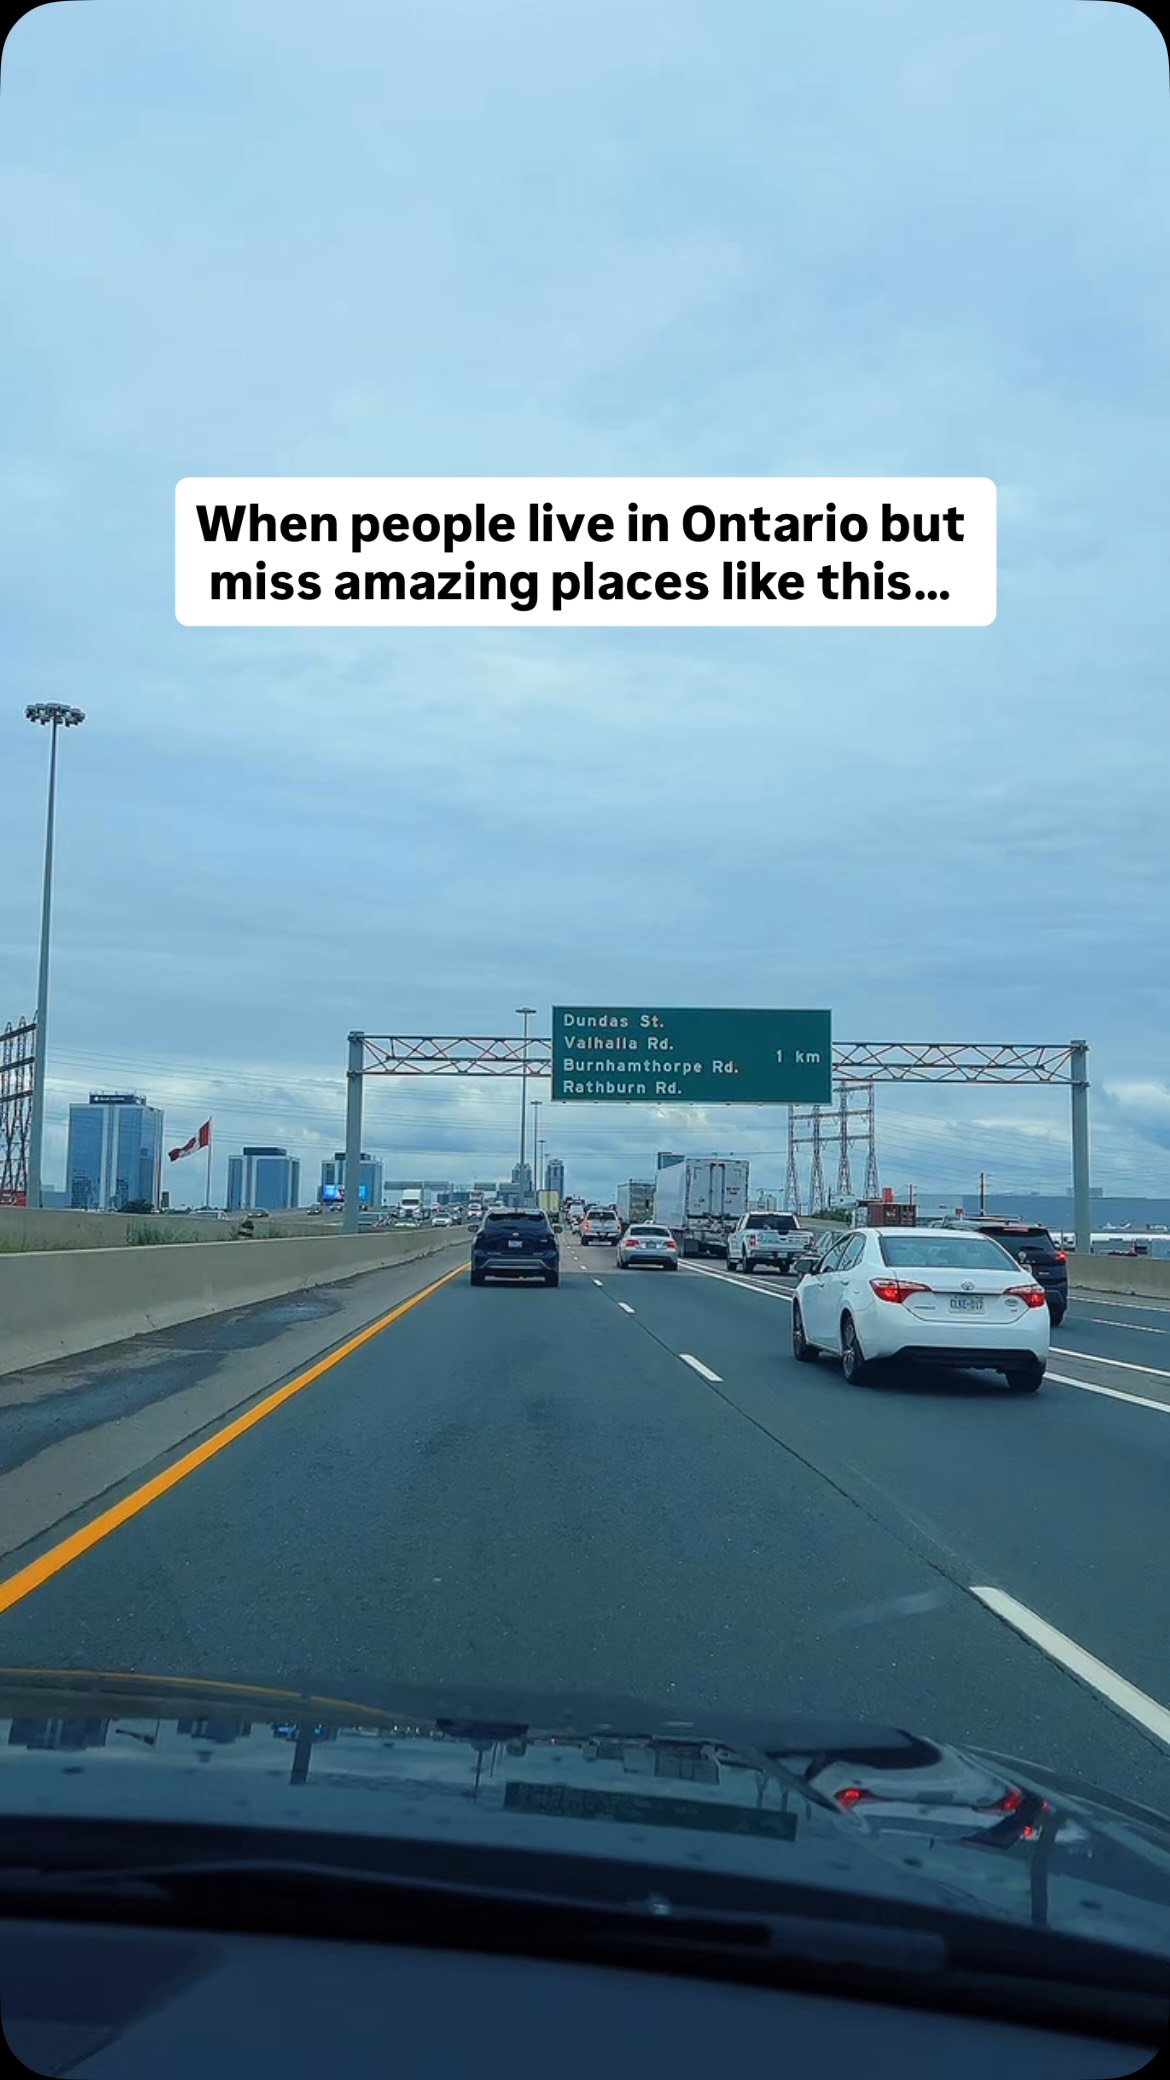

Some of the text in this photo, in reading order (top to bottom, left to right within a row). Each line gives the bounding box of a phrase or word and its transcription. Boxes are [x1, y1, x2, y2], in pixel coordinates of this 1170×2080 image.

[563, 1013, 664, 1028] Dundas St.
[564, 1036, 674, 1051] Valhalla Rd.
[776, 1050, 820, 1064] 1 km
[563, 1058, 739, 1076] Burnhamthorpe Rd.
[563, 1080, 682, 1096] Rathburn Rd.
